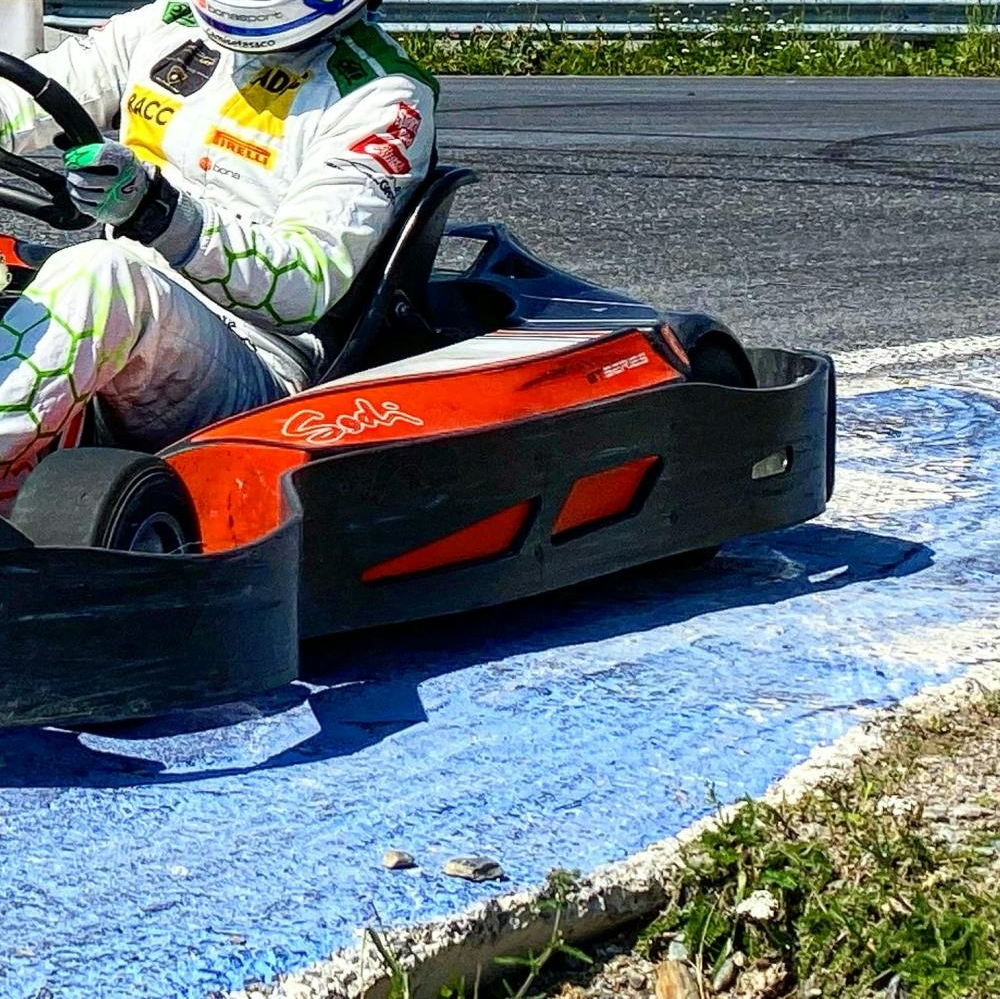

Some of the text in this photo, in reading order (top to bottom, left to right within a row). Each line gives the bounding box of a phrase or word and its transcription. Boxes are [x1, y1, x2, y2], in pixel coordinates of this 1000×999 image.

[208, 4, 283, 22] bonasport
[127, 93, 175, 125] RACC
[211, 130, 271, 166] PIRELLI
[281, 398, 424, 444] Sodi
